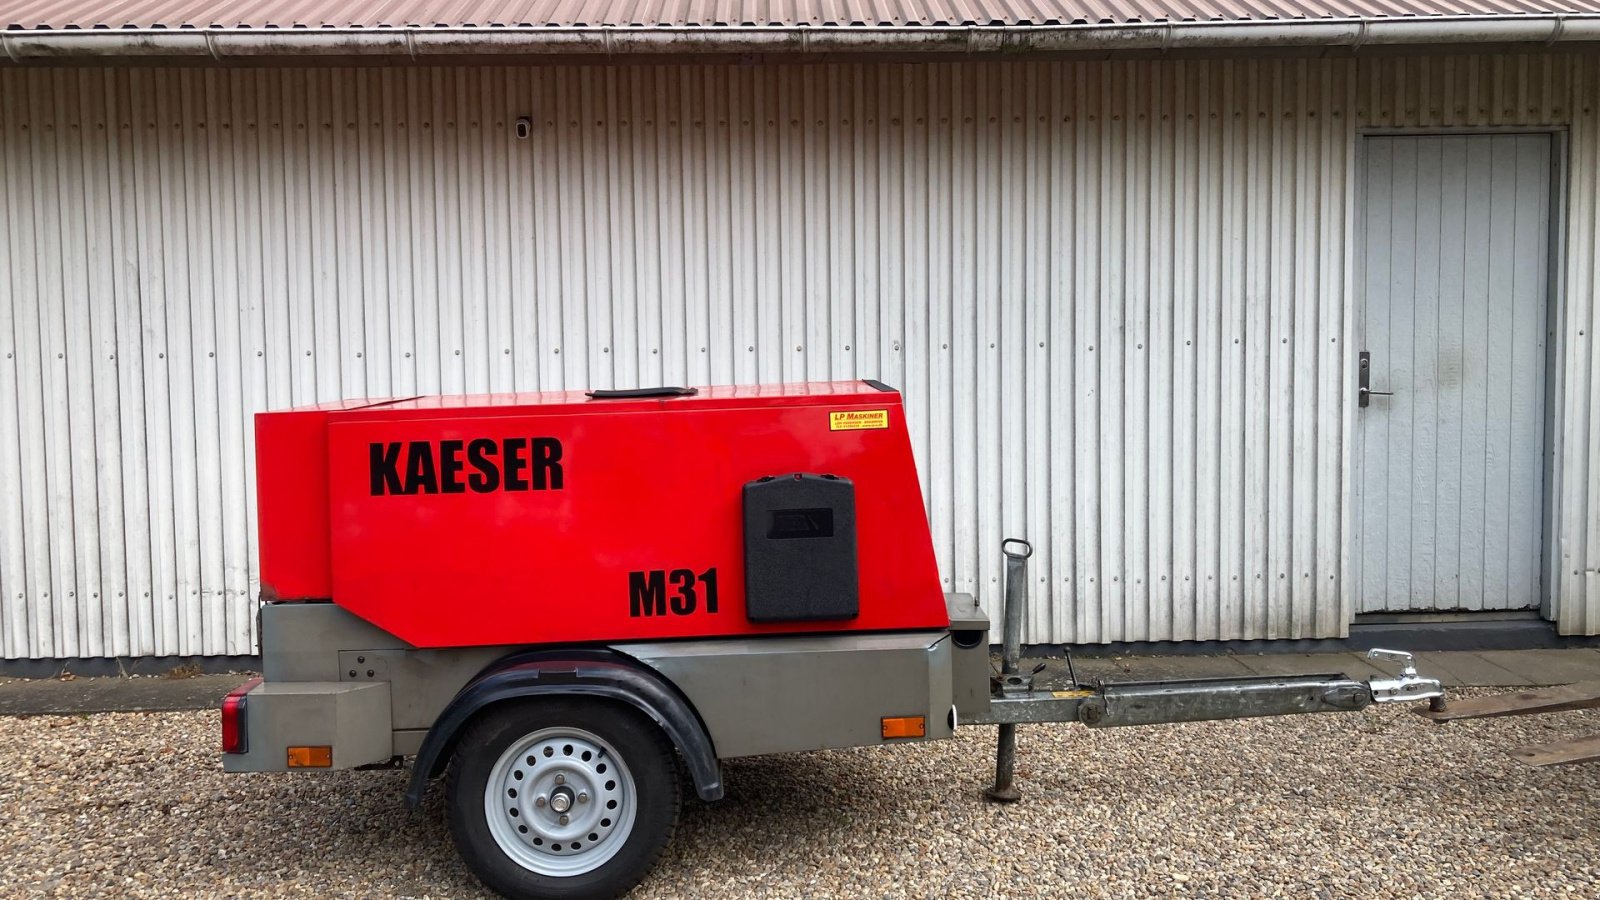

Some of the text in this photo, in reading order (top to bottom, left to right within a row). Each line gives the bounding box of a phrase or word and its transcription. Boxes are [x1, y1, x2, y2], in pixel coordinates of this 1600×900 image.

[834, 413, 846, 421] LP
[369, 437, 564, 496] KAESER
[628, 567, 719, 618] M31
